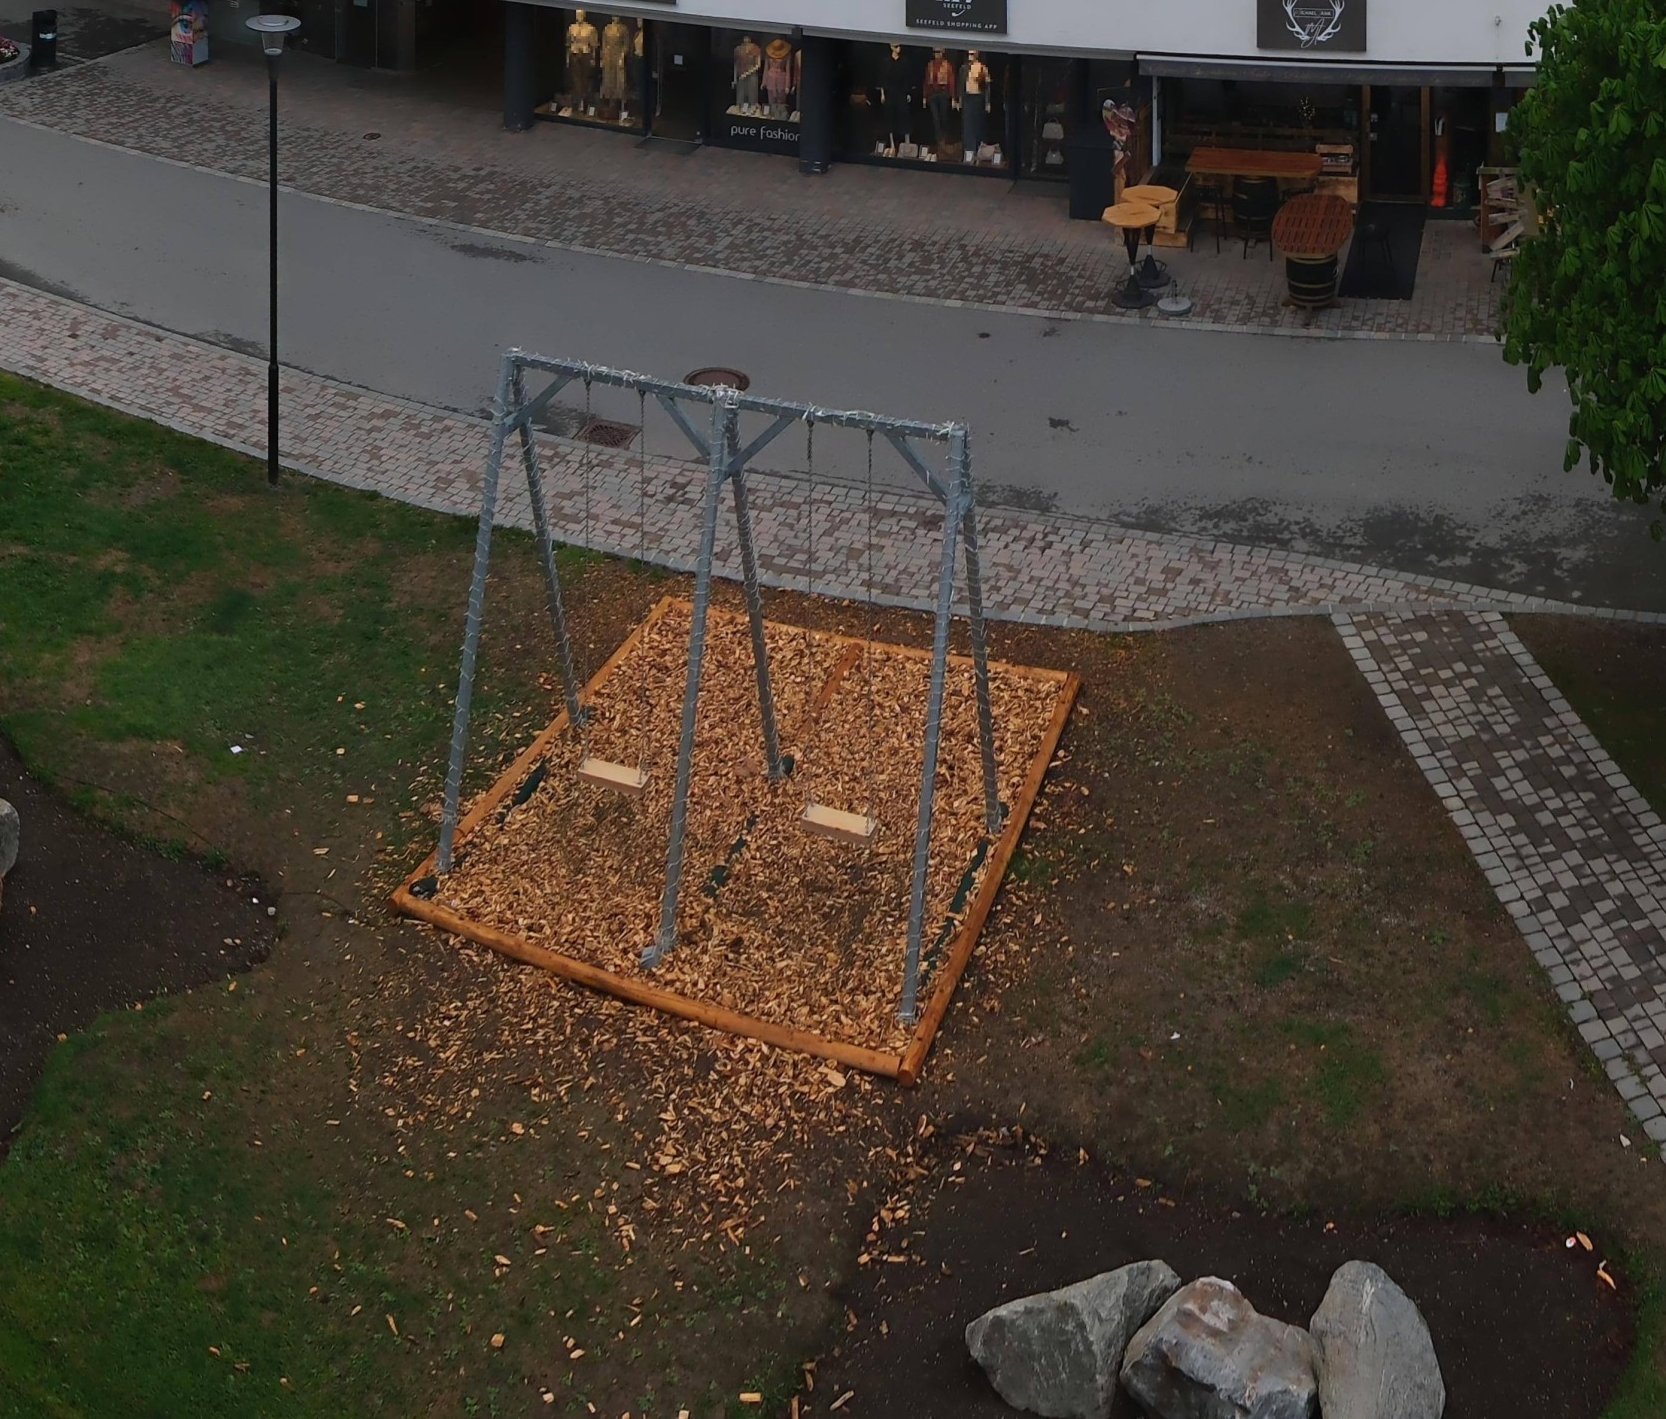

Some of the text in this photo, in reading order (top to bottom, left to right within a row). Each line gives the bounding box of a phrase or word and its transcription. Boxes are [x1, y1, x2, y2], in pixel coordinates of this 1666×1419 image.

[916, 18, 945, 26] SEEFELD
[946, 21, 982, 29] SHOPPING
[730, 125, 757, 137] pure
